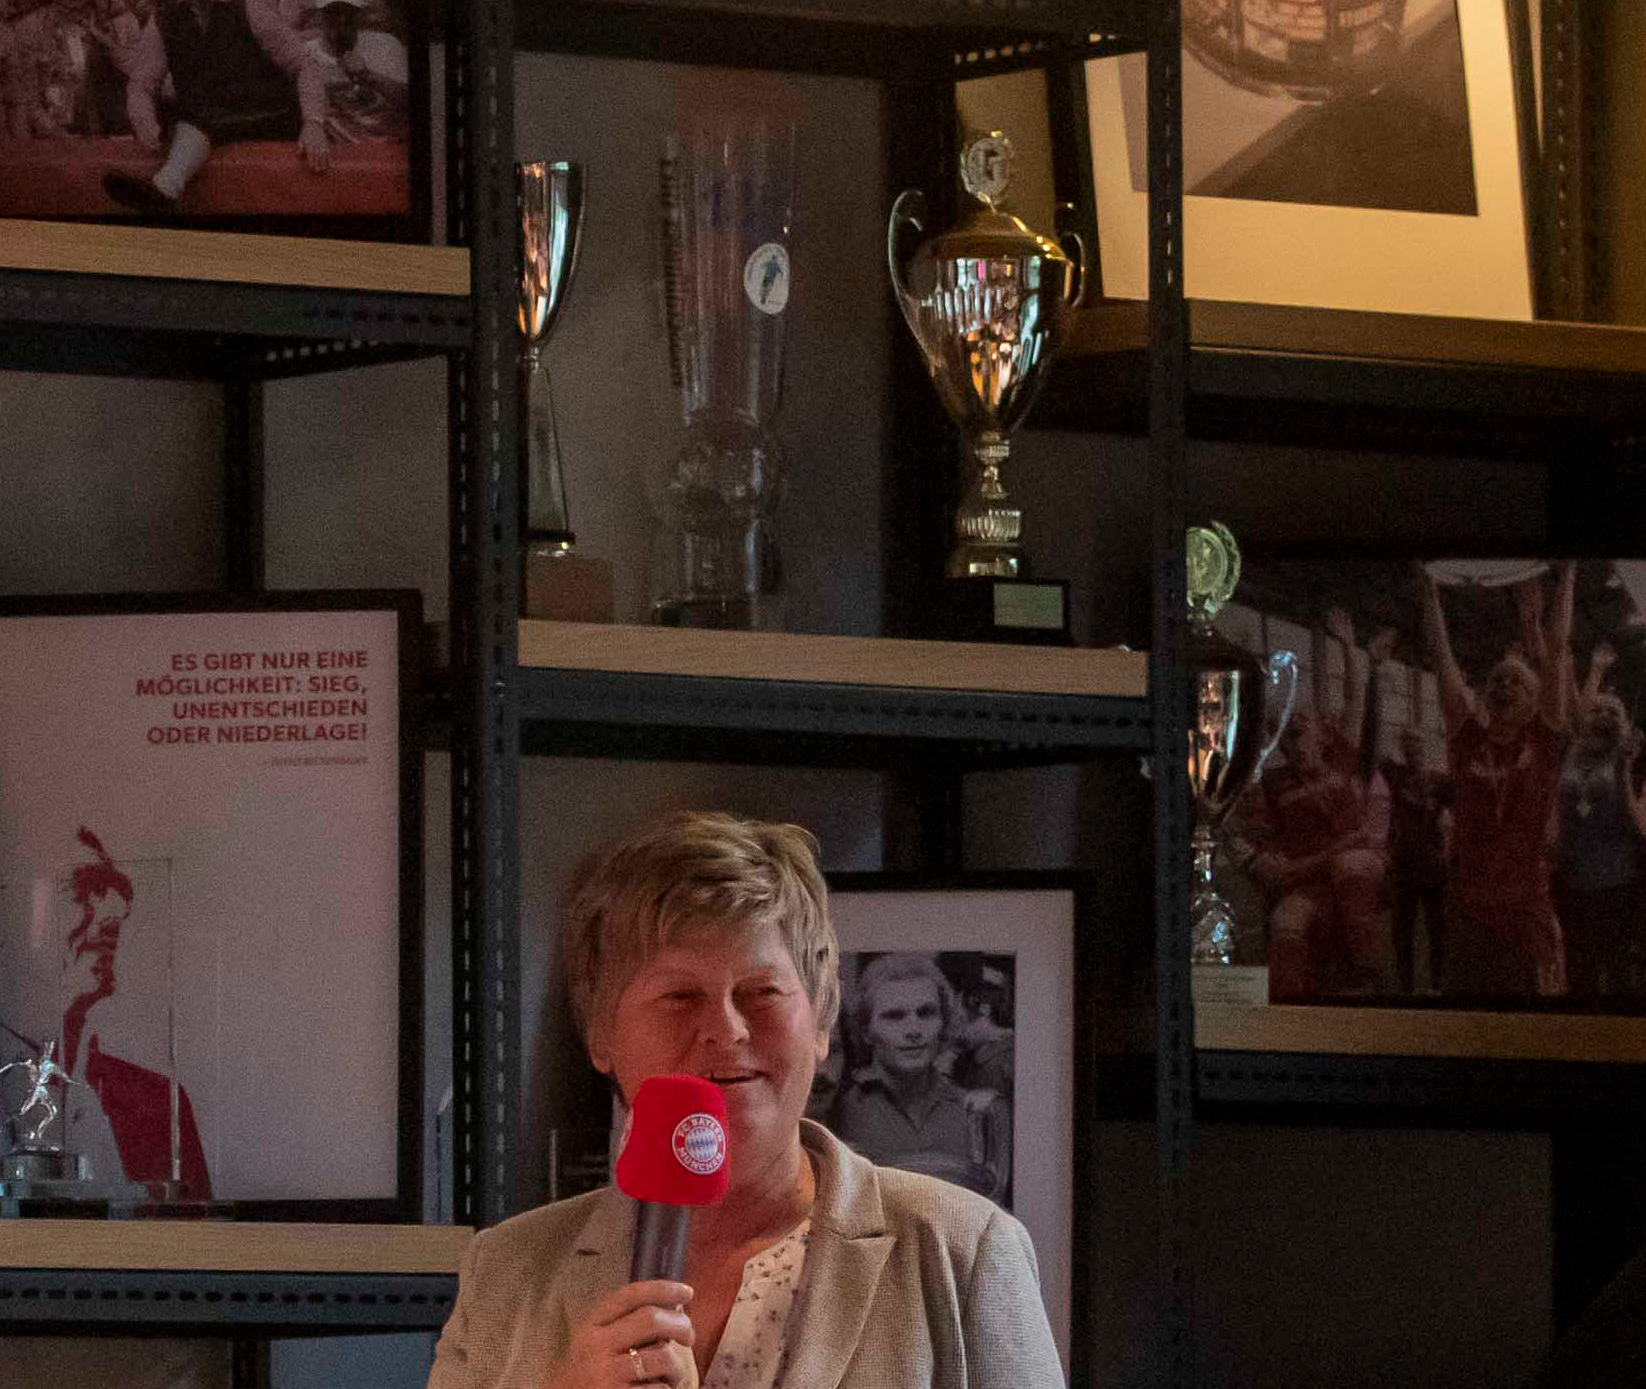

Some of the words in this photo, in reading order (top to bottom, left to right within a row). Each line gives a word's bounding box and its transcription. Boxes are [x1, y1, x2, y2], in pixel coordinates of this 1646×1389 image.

[171, 653, 197, 671] ES
[204, 652, 255, 671] GIBT
[262, 651, 310, 669] NUR
[316, 650, 368, 668] EINE
[136, 674, 301, 696] MÖGLICHKEIT:
[308, 675, 367, 695] SIEG,
[172, 699, 367, 719] UNENTSCHIEDEN
[147, 725, 210, 745] ODER
[217, 723, 367, 744] NIEDERLAGE!
